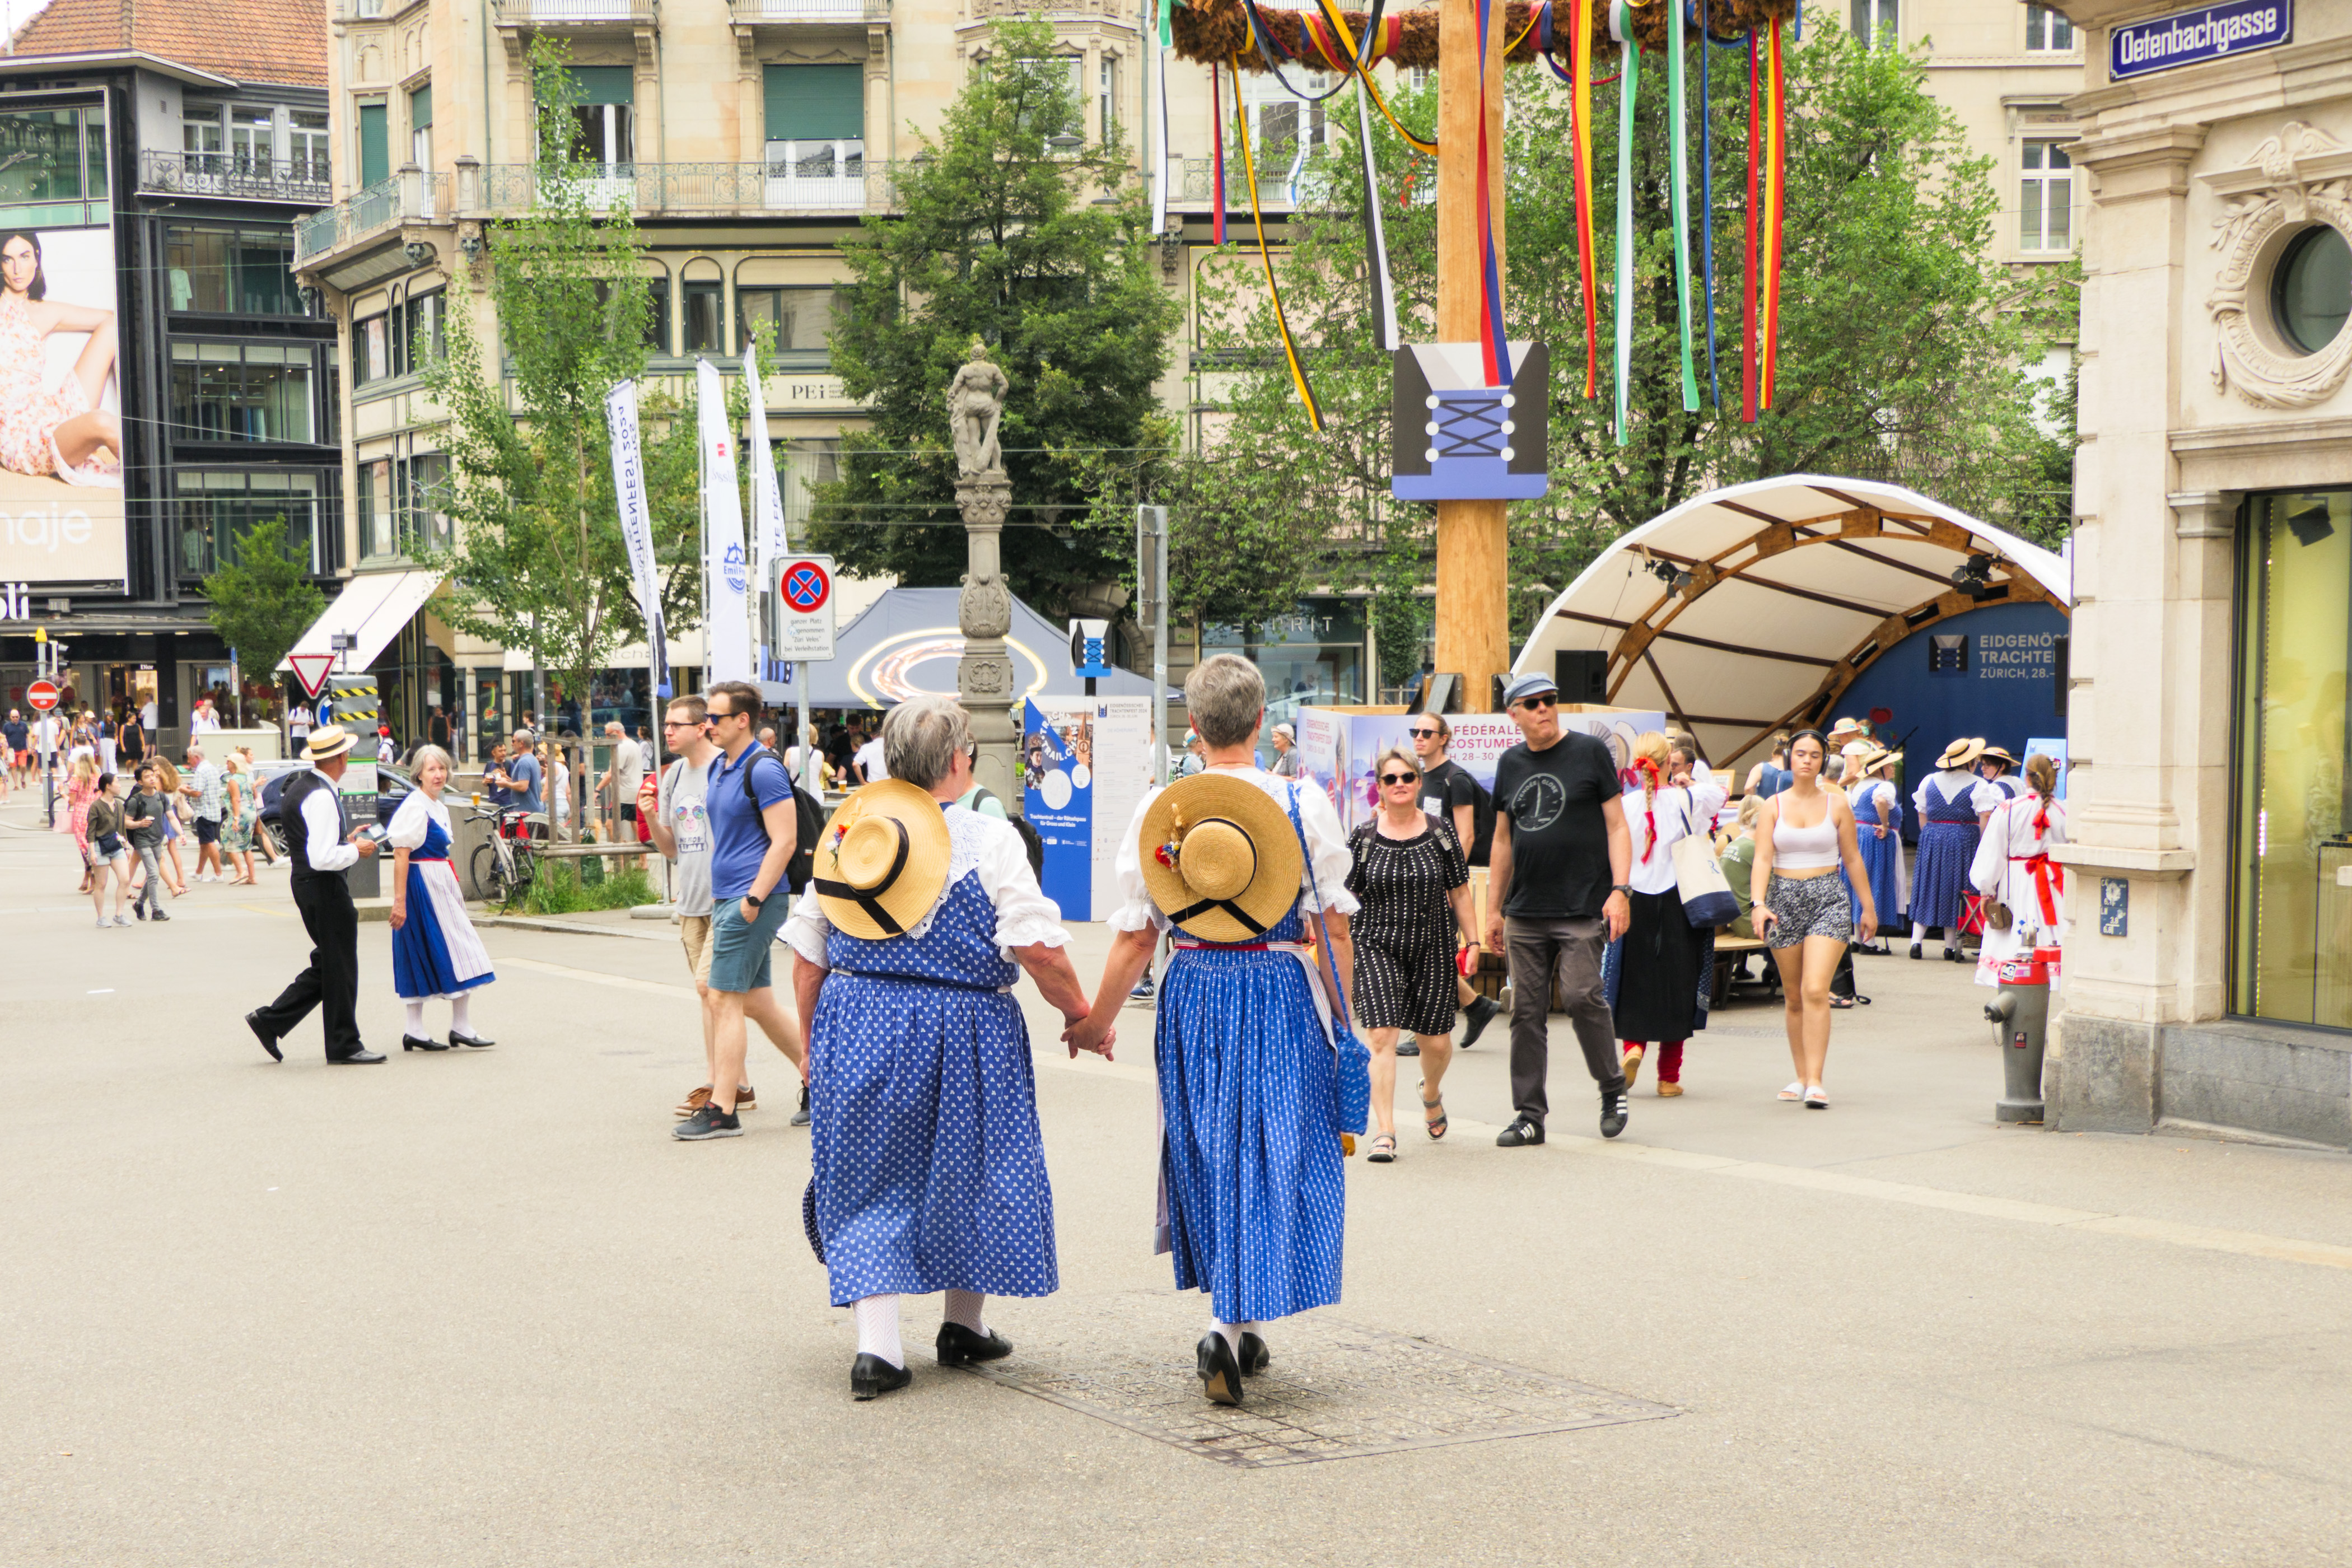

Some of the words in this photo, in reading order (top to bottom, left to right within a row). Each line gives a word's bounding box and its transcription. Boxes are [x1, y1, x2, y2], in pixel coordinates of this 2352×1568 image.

[2120, 7, 2278, 66] Oetenbachgasse
[724, 566, 738, 575] Emil
[1980, 651, 2055, 664] TRACHTE
[1980, 666, 2029, 679] ZÜRICH,
[1454, 724, 1523, 735] FÉDÉRALE
[1448, 738, 1522, 749] COSTUMES
[1516, 780, 1537, 801] VENDÉE
[1541, 779, 1558, 794] GLOBE
